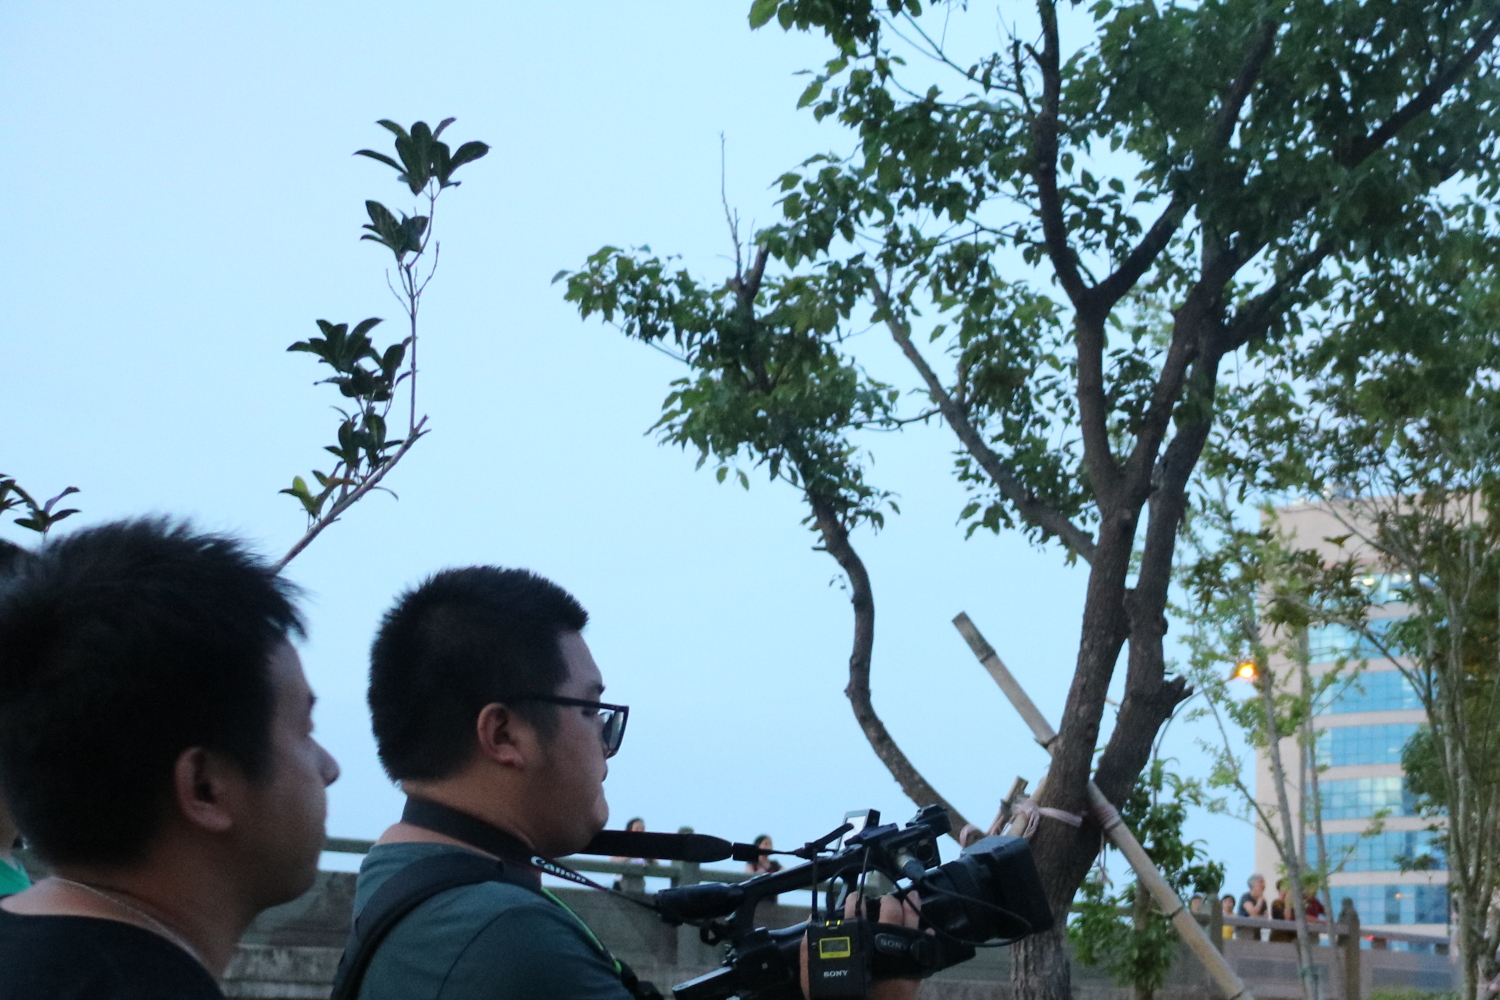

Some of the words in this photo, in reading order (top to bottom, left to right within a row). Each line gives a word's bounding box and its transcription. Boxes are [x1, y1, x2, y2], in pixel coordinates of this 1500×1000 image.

[531, 856, 586, 883] Canon
[880, 938, 908, 951] SONY
[823, 969, 849, 979] SONY
